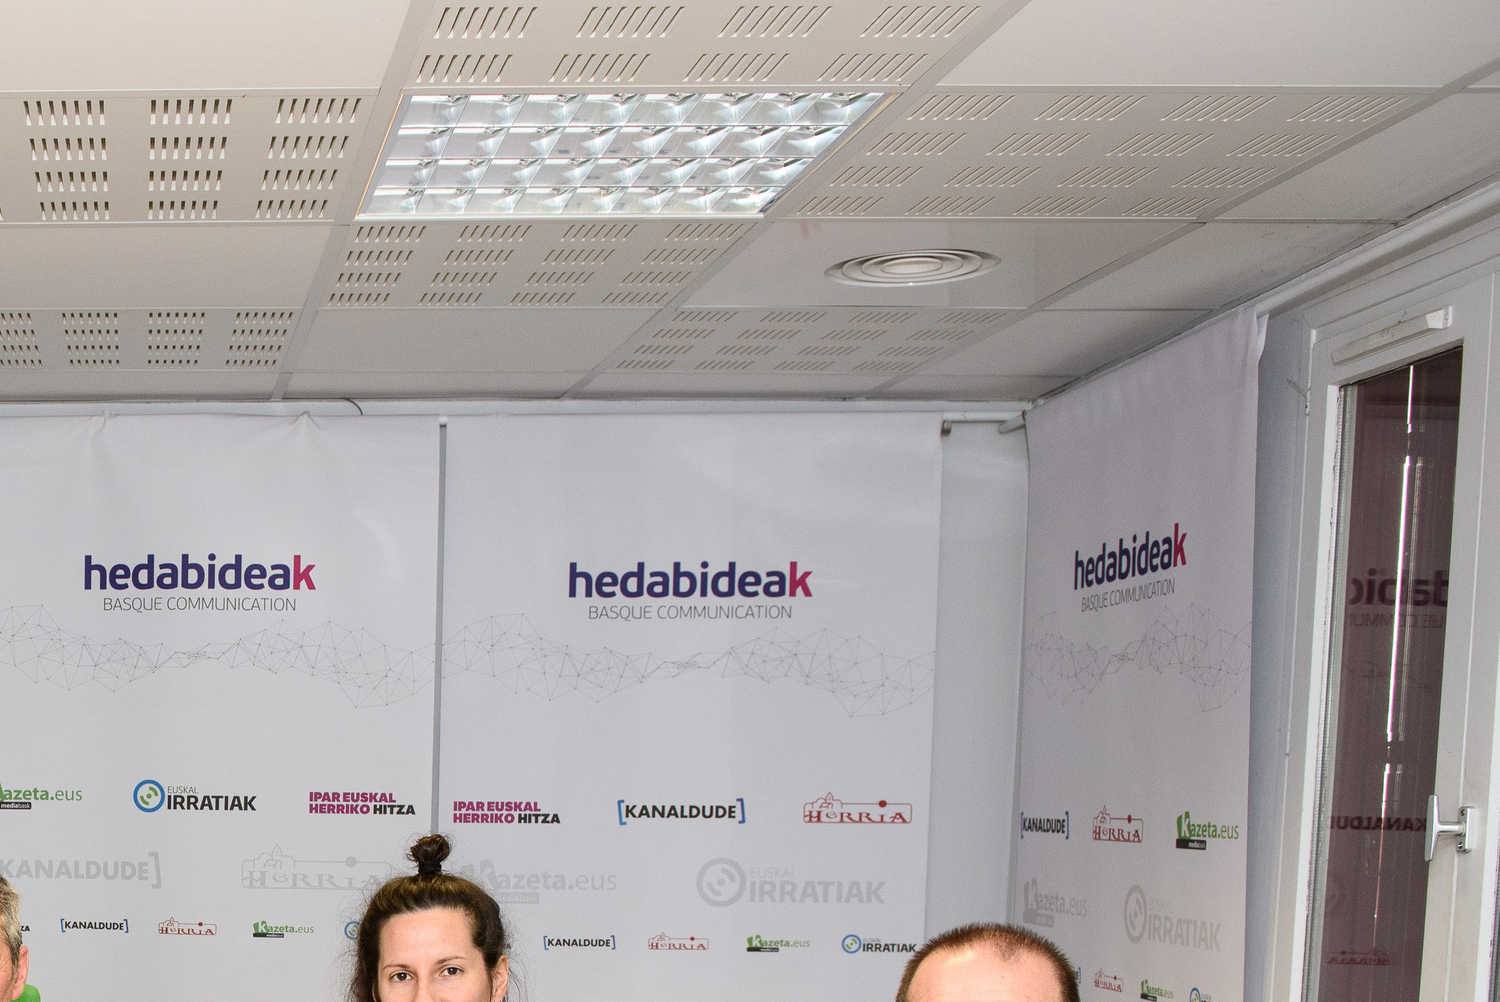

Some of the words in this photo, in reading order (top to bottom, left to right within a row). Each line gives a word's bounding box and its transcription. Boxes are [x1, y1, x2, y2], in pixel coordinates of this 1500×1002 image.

[1074, 522, 1187, 590] hedabideak
[85, 553, 316, 590] hedabideak
[569, 561, 812, 598] hedabideak
[1081, 591, 1108, 612] BASQUE
[1109, 578, 1175, 606] COMMUNICATION
[103, 597, 162, 613] BASQUE
[167, 597, 296, 611] COMMUNICATION
[588, 605, 652, 622] BASQUE
[657, 605, 792, 619] COMMUNICATION
[168, 786, 199, 794] EUSKAL
[309, 792, 340, 802] IPAR
[343, 792, 396, 803] EUSKAL
[167, 795, 257, 811] IRRATIAK
[309, 804, 370, 814] HERRIKO
[373, 804, 416, 815] HITZA
[453, 801, 484, 811] IPAR
[487, 802, 541, 812] EUSKAL
[453, 813, 515, 823] HERRIKO
[518, 814, 561, 823] HITZA
[750, 880, 886, 904] IRRATIAK
[1147, 914, 1222, 952] IRRATIAK
[862, 943, 917, 953] IRRATIAK
